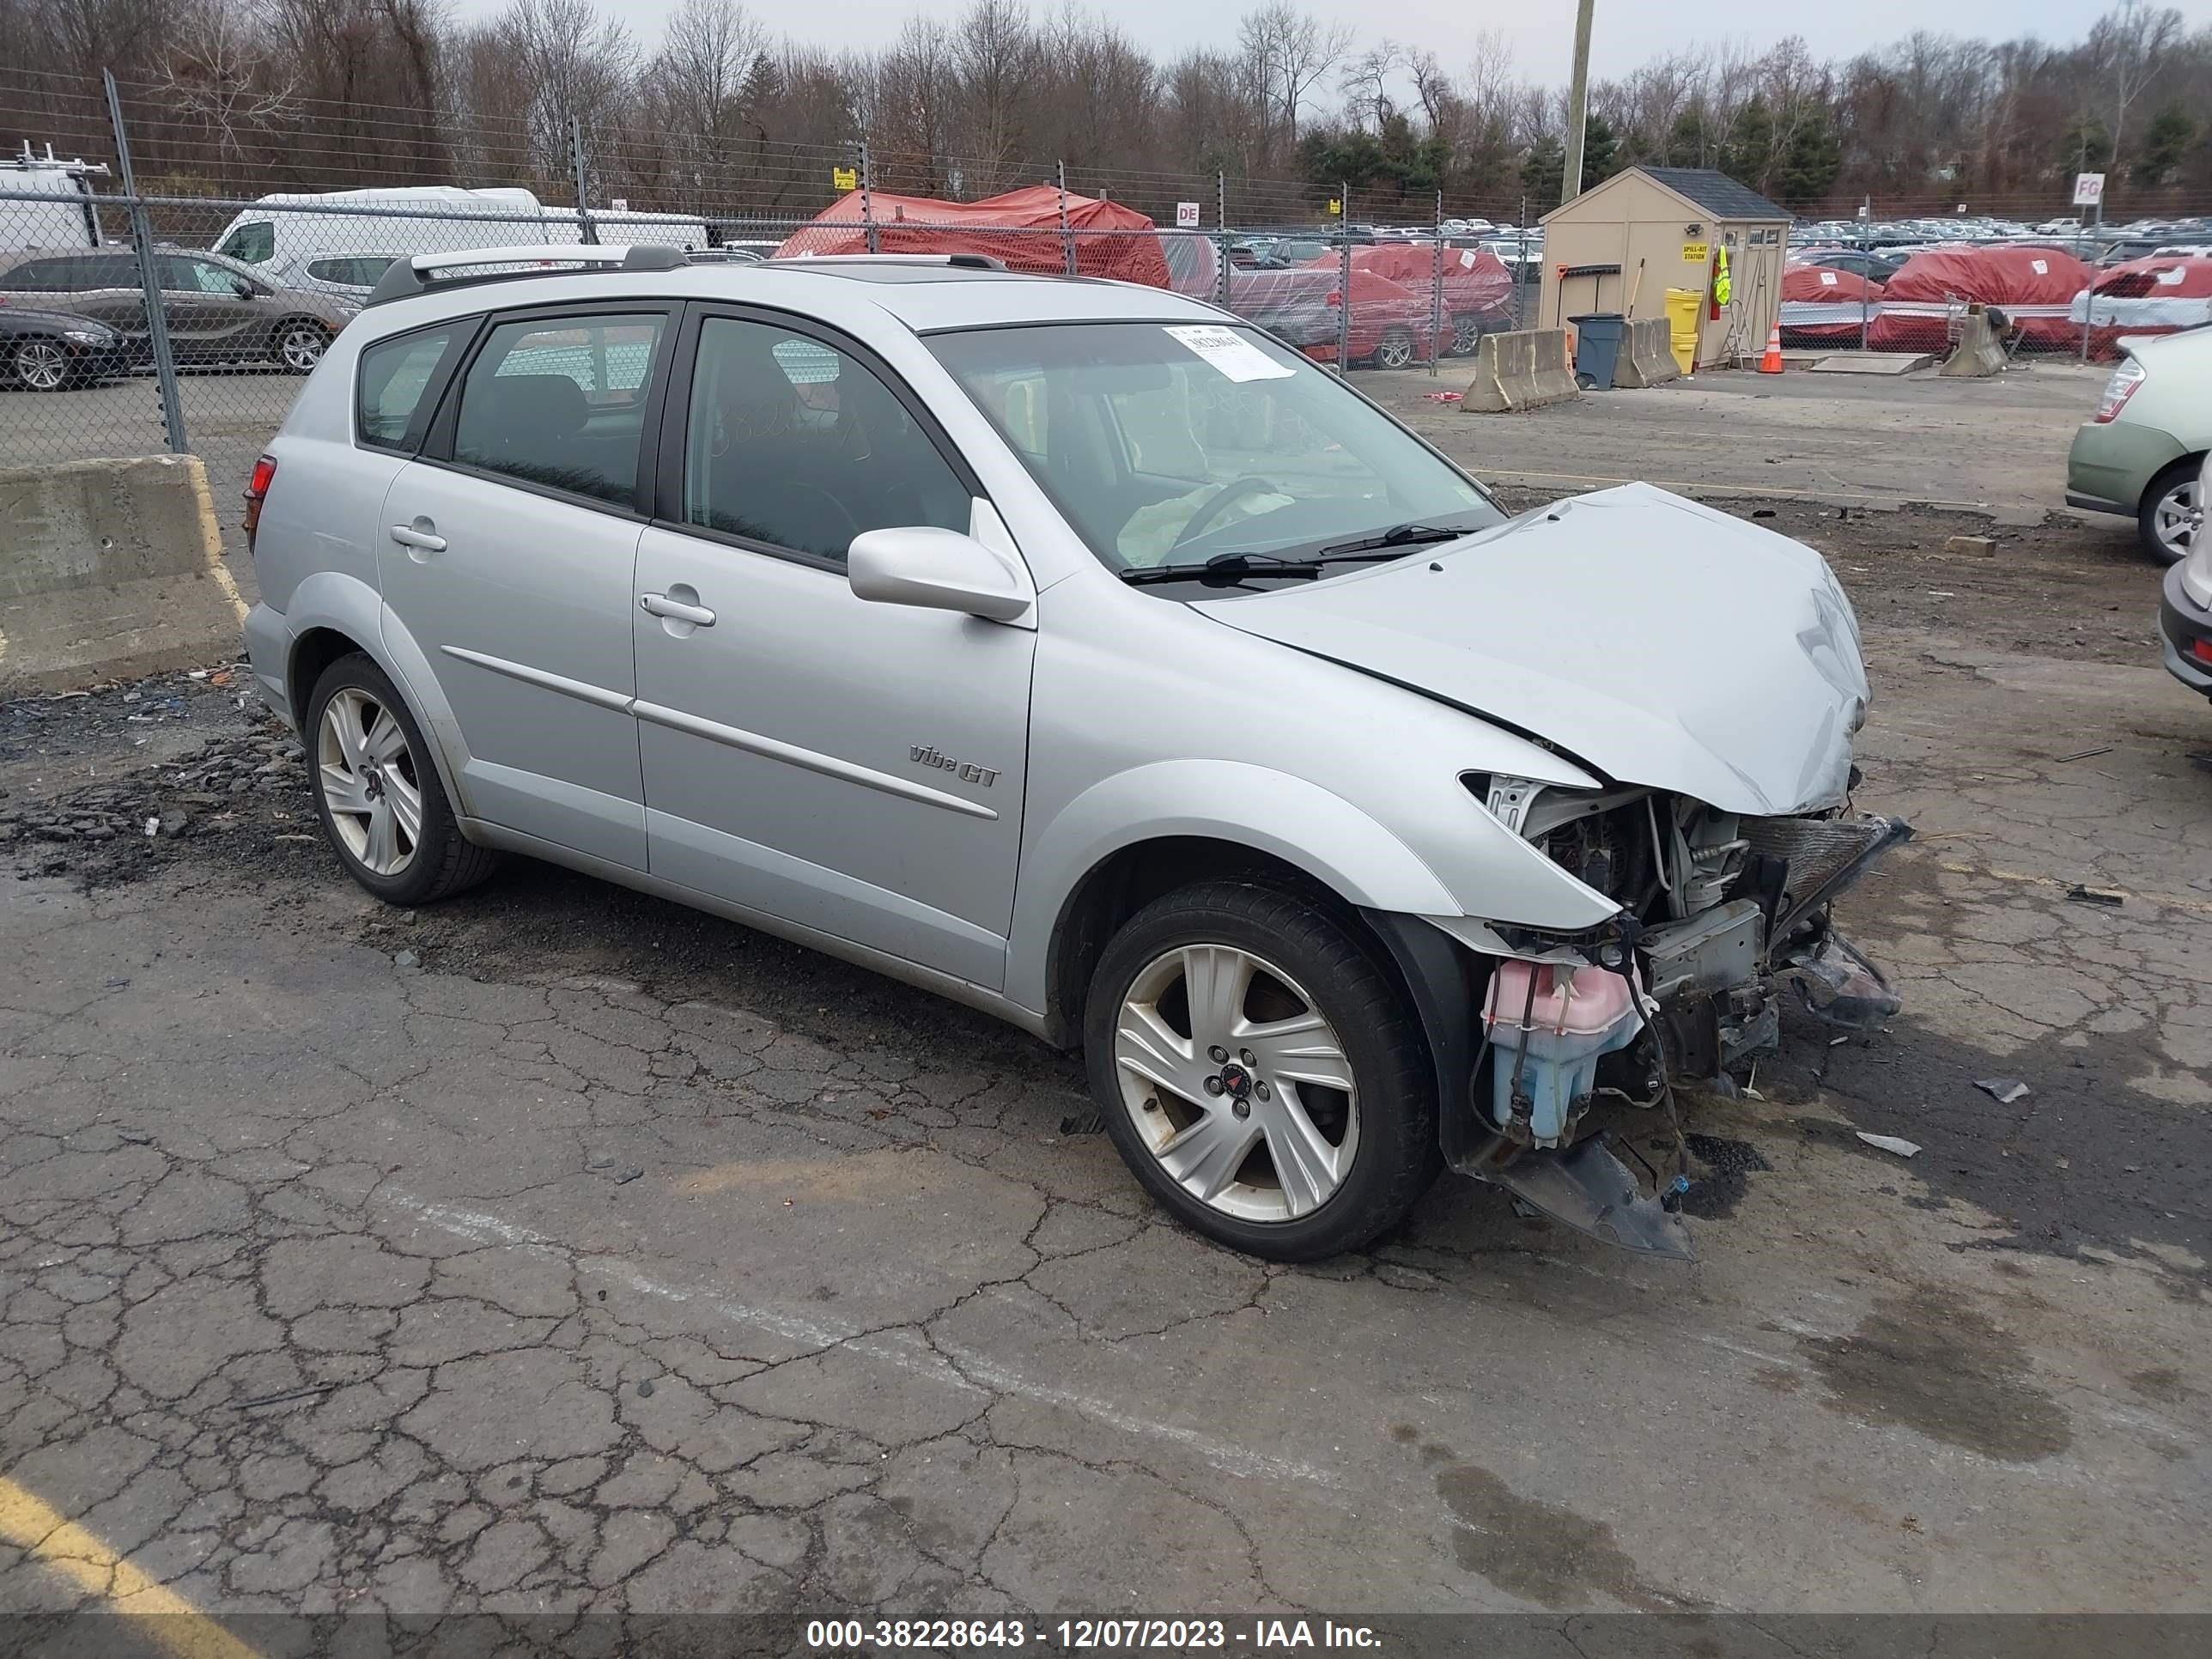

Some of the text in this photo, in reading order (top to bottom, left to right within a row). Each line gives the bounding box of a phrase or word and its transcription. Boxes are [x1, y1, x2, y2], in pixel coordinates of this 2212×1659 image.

[2079, 180, 2100, 196] FG
[1180, 209, 1197, 220] DE
[959, 762, 1001, 787] GT
